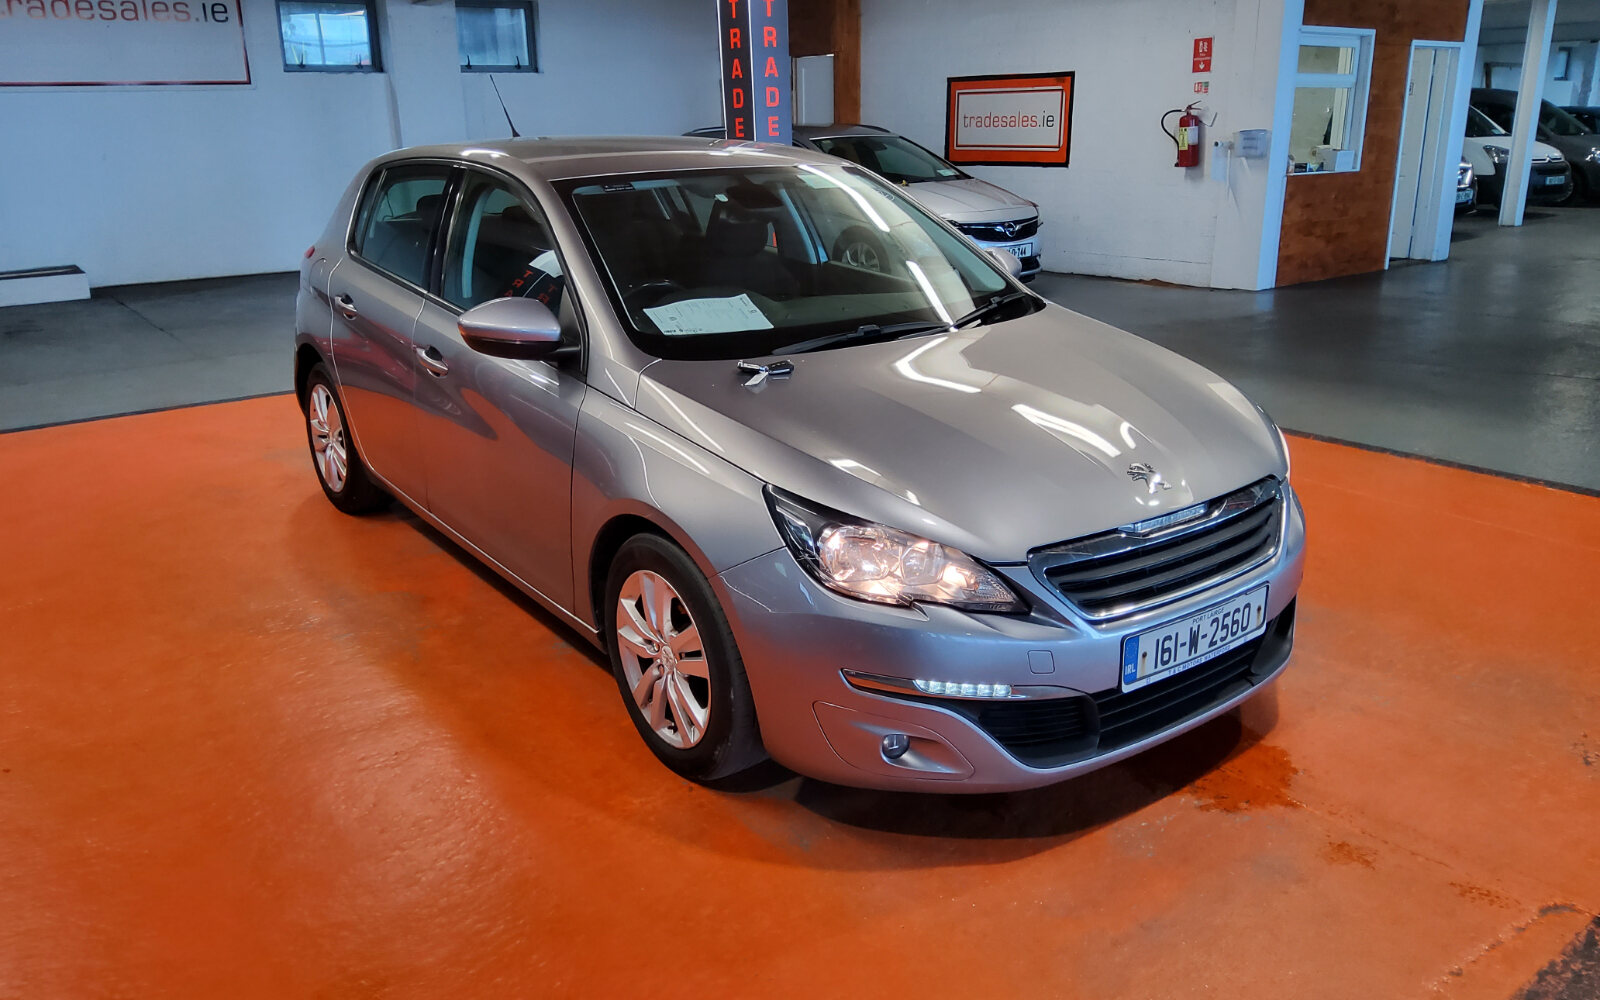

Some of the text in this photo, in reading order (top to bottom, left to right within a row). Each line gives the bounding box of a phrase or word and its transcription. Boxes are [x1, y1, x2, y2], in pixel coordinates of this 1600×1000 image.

[0, 0, 229, 23] radesales.ie
[729, 0, 744, 137] TRADE
[763, 0, 779, 136] TRADE
[963, 110, 1055, 128] tradesales.ie
[1192, 614, 1206, 624] PORT
[1154, 602, 1252, 669] 161-W-2560
[1124, 663, 1137, 675] IRL
